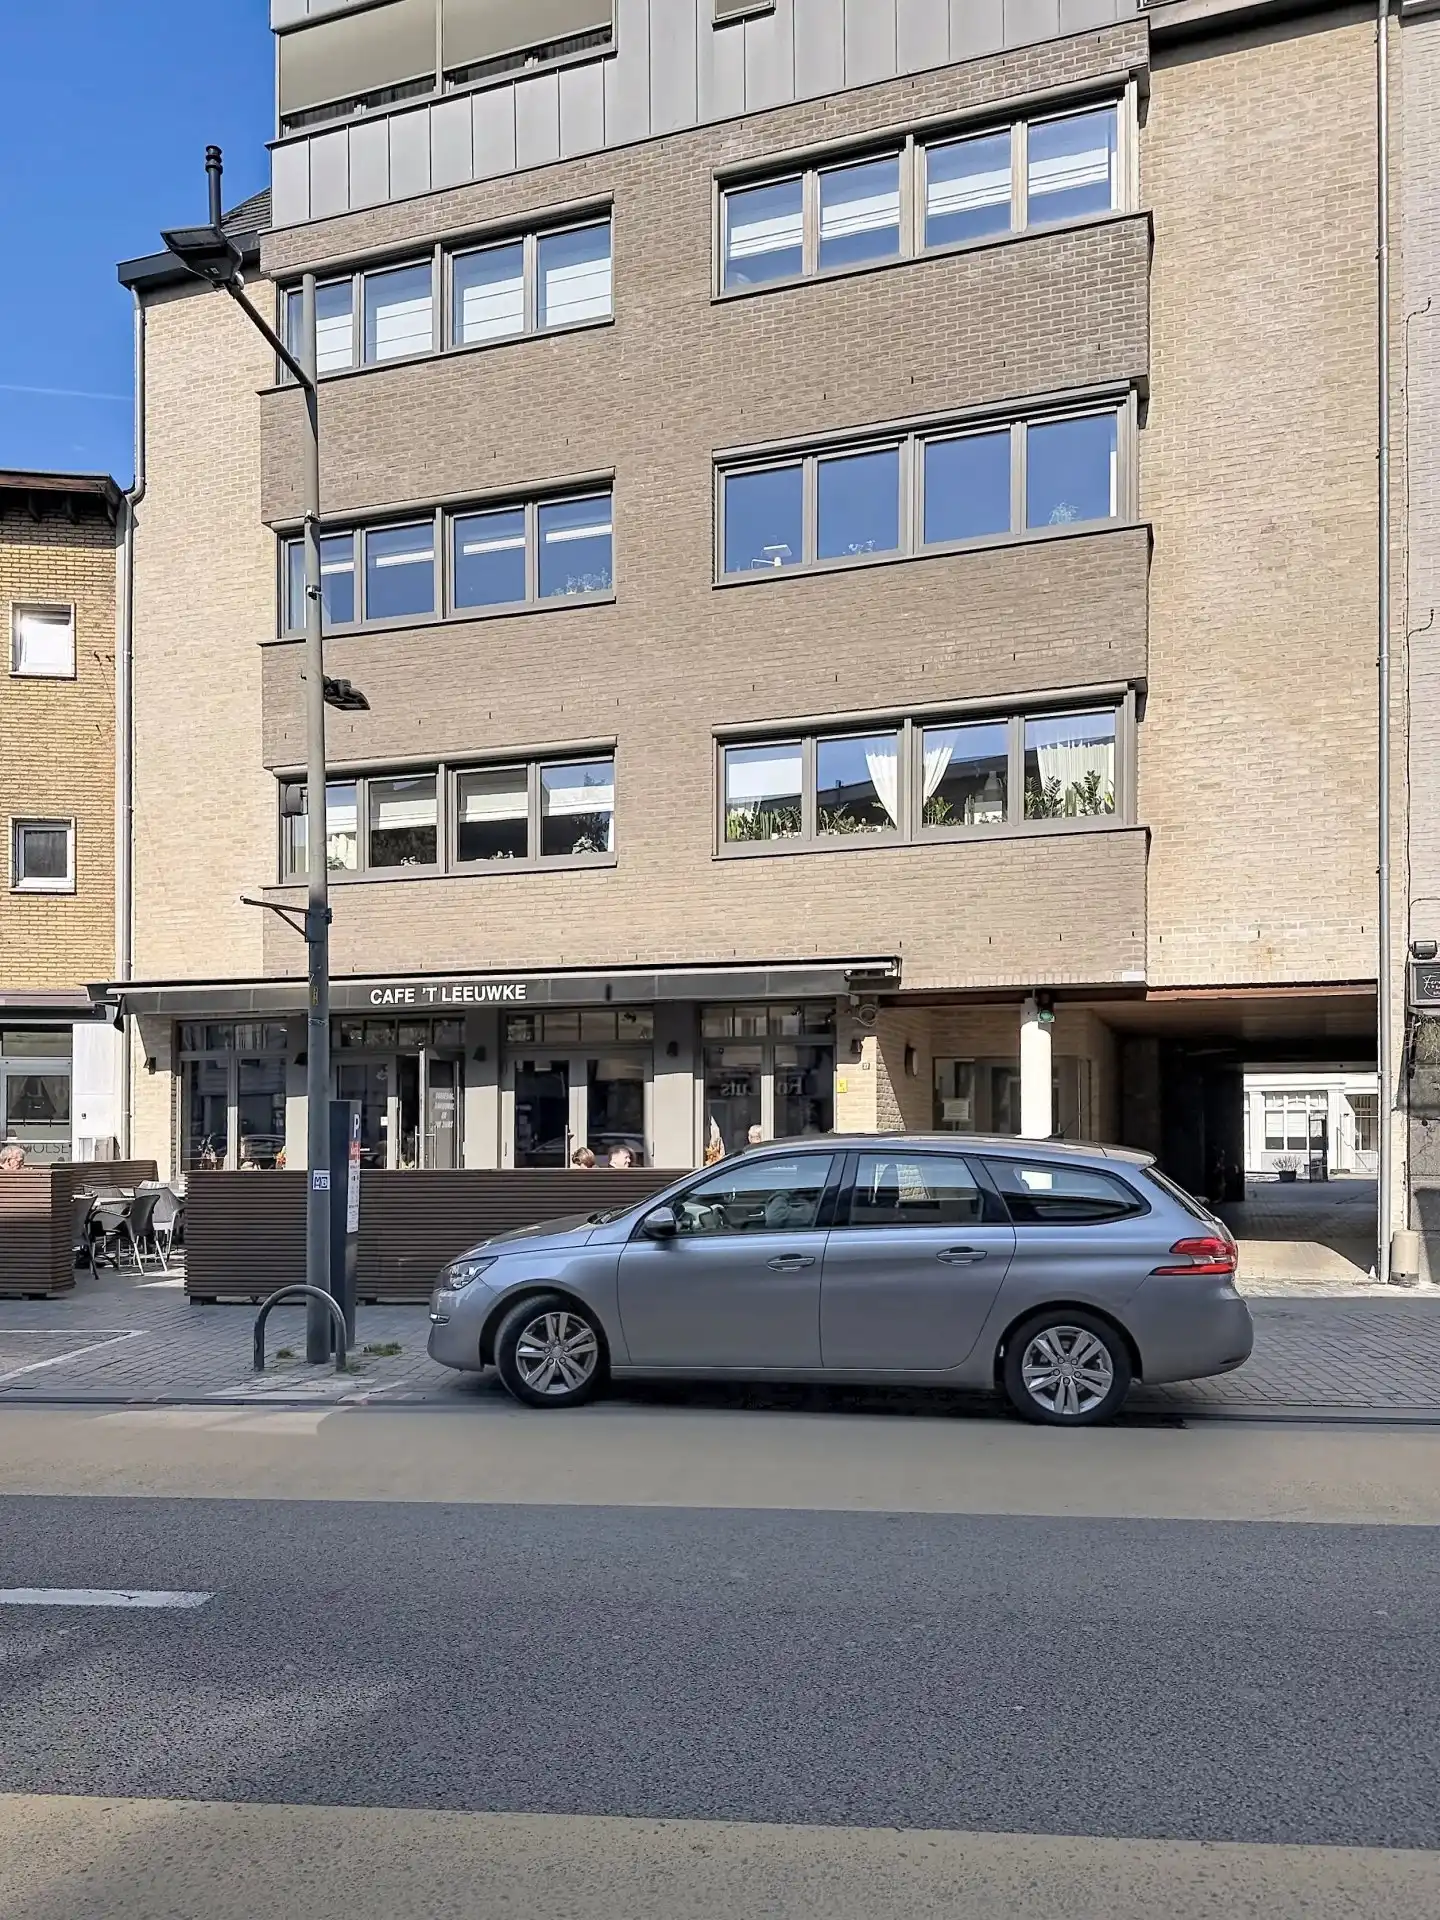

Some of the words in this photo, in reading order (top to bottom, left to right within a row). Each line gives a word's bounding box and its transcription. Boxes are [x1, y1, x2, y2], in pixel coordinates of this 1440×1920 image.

[370, 987, 415, 1005] CAFE
[441, 984, 527, 1002] LEEUWKE
[353, 1113, 360, 1138] P
